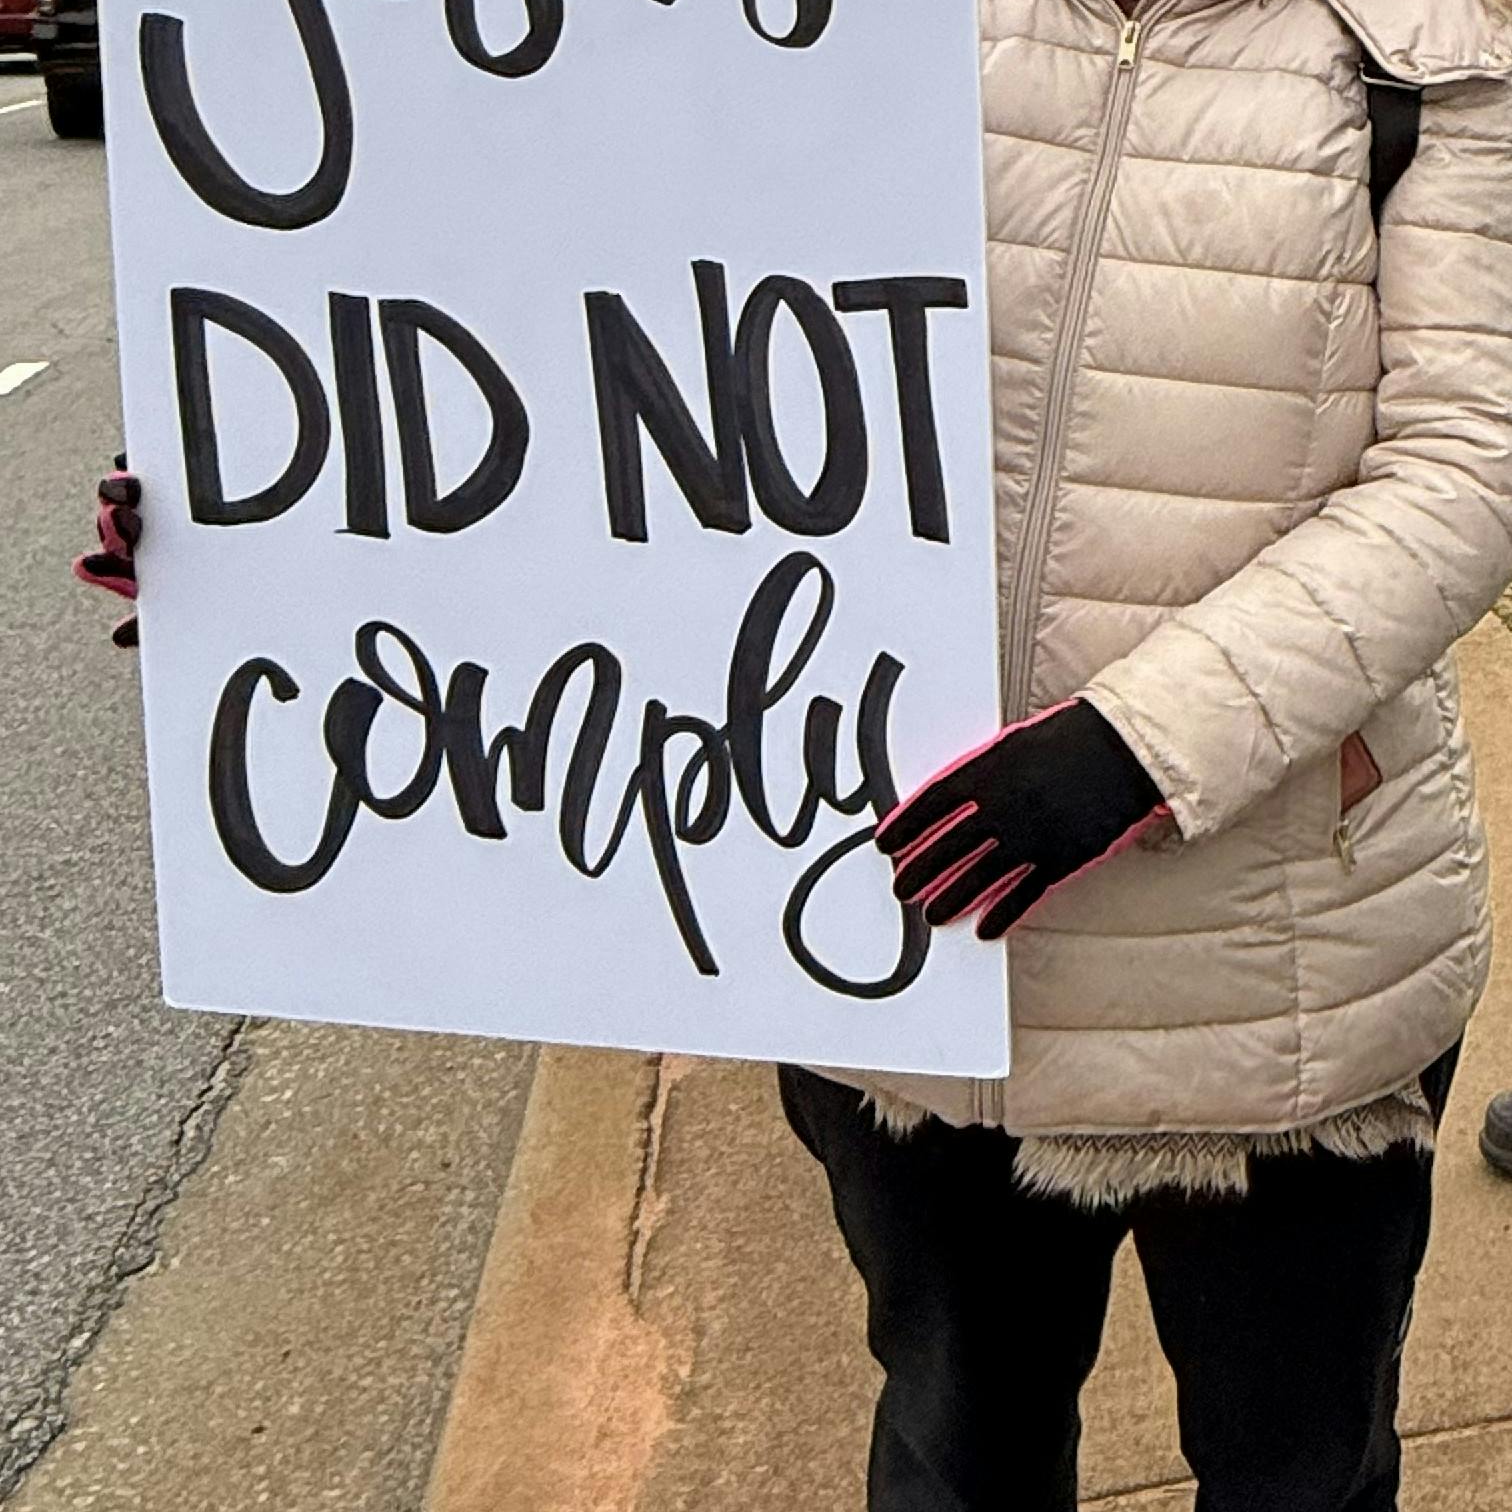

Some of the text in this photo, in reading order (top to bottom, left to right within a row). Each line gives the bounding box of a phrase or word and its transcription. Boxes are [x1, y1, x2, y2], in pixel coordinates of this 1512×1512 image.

[170, 259, 969, 544] DID NOT
[208, 551, 931, 1000] comply
